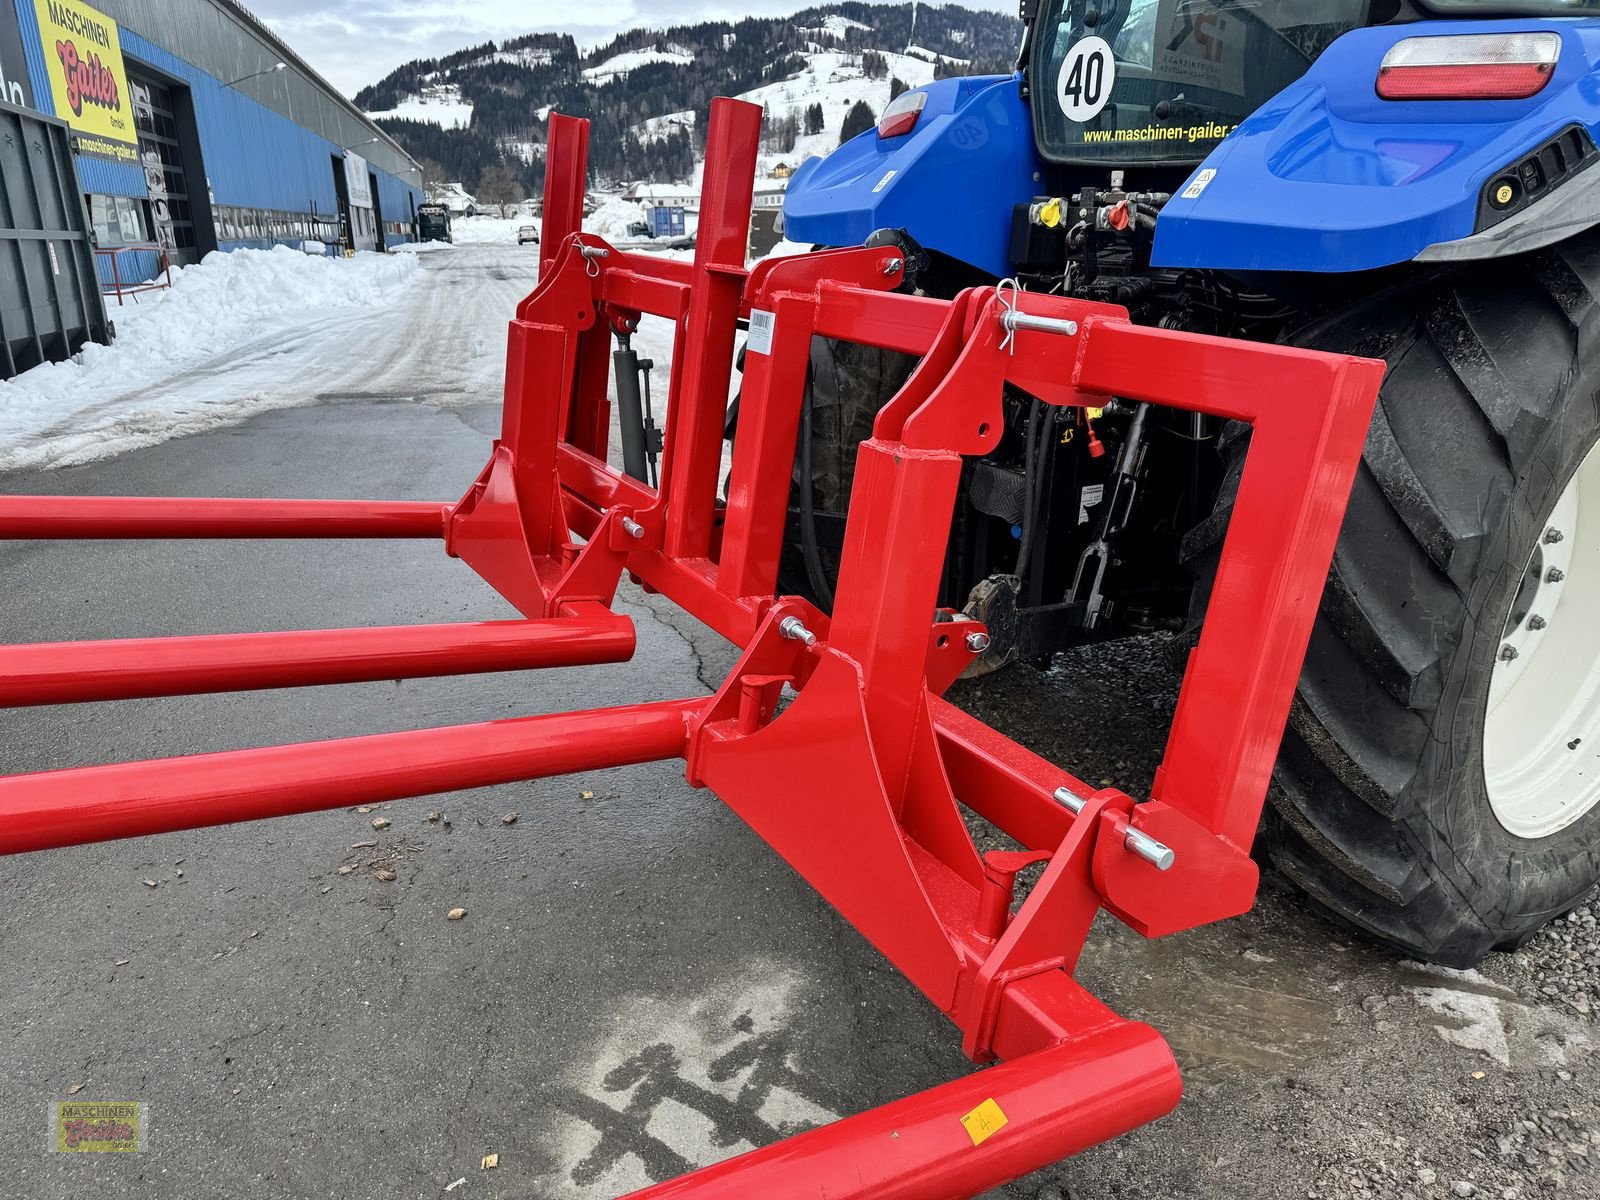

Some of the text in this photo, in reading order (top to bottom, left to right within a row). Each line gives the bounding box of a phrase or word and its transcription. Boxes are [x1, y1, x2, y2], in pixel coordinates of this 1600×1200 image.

[47, 0, 111, 49] MASCHINEN
[55, 39, 121, 118] Gailer
[1065, 51, 1104, 107] 40
